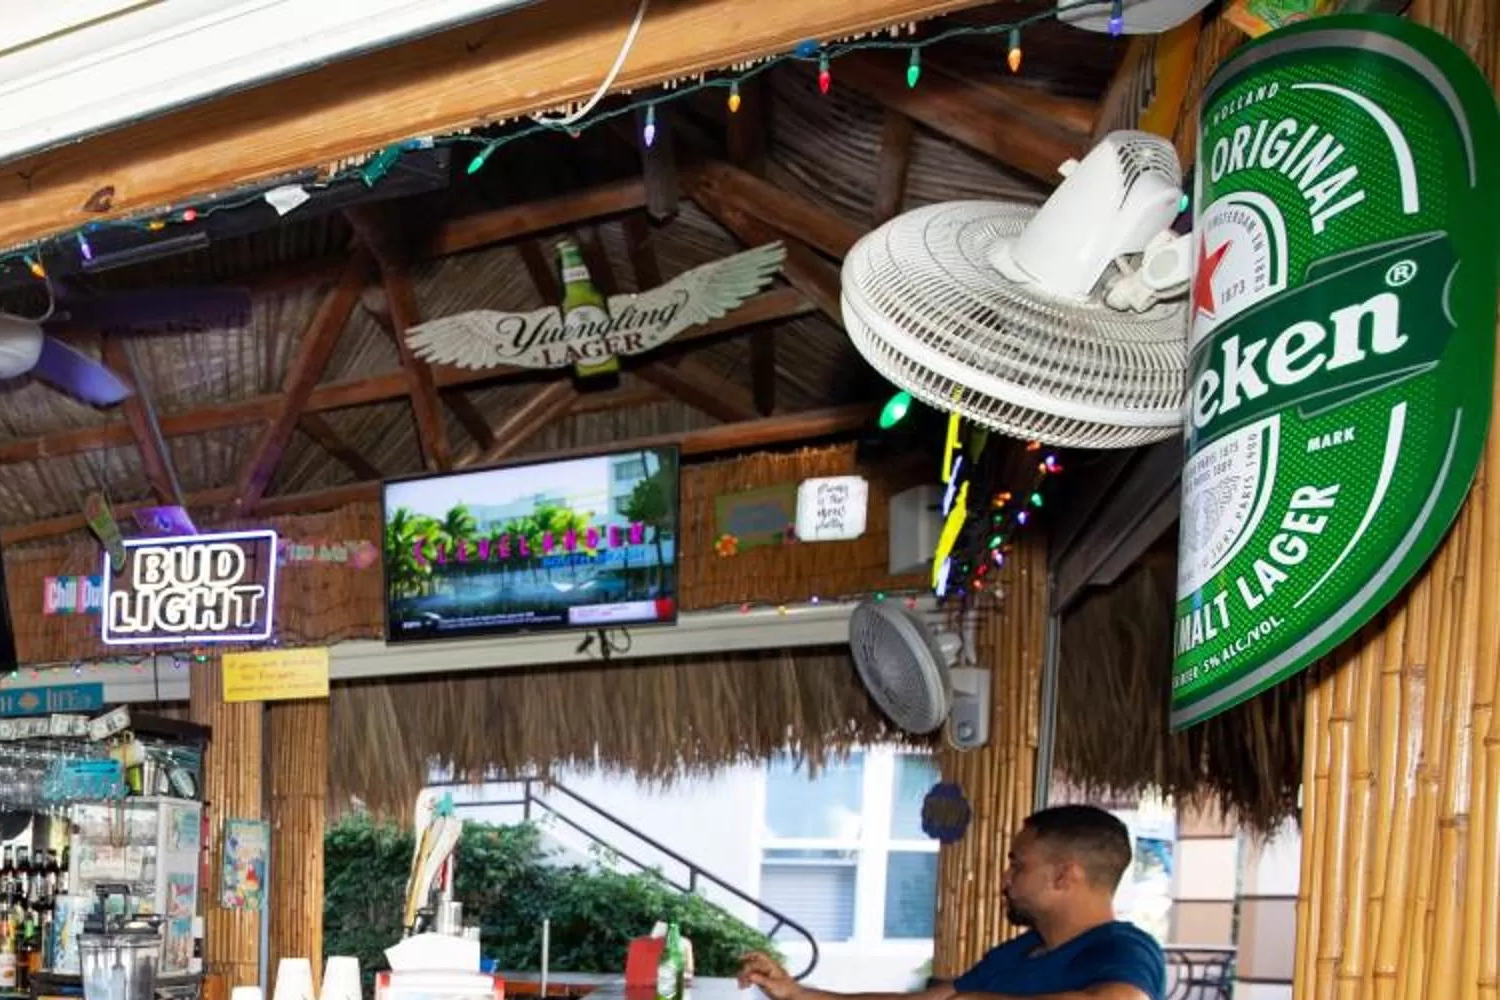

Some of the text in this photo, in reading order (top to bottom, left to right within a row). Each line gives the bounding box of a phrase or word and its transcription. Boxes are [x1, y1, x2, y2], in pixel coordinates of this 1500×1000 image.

[1211, 118, 1366, 236] ORIGINAL
[496, 288, 689, 357] Yuengling
[542, 331, 644, 366] LAGER
[1307, 427, 1355, 453] MARK
[134, 544, 244, 590] BUD
[1178, 483, 1341, 655] MALT LAGER
[48, 580, 77, 610] Chill
[110, 585, 265, 632] LIGHT
